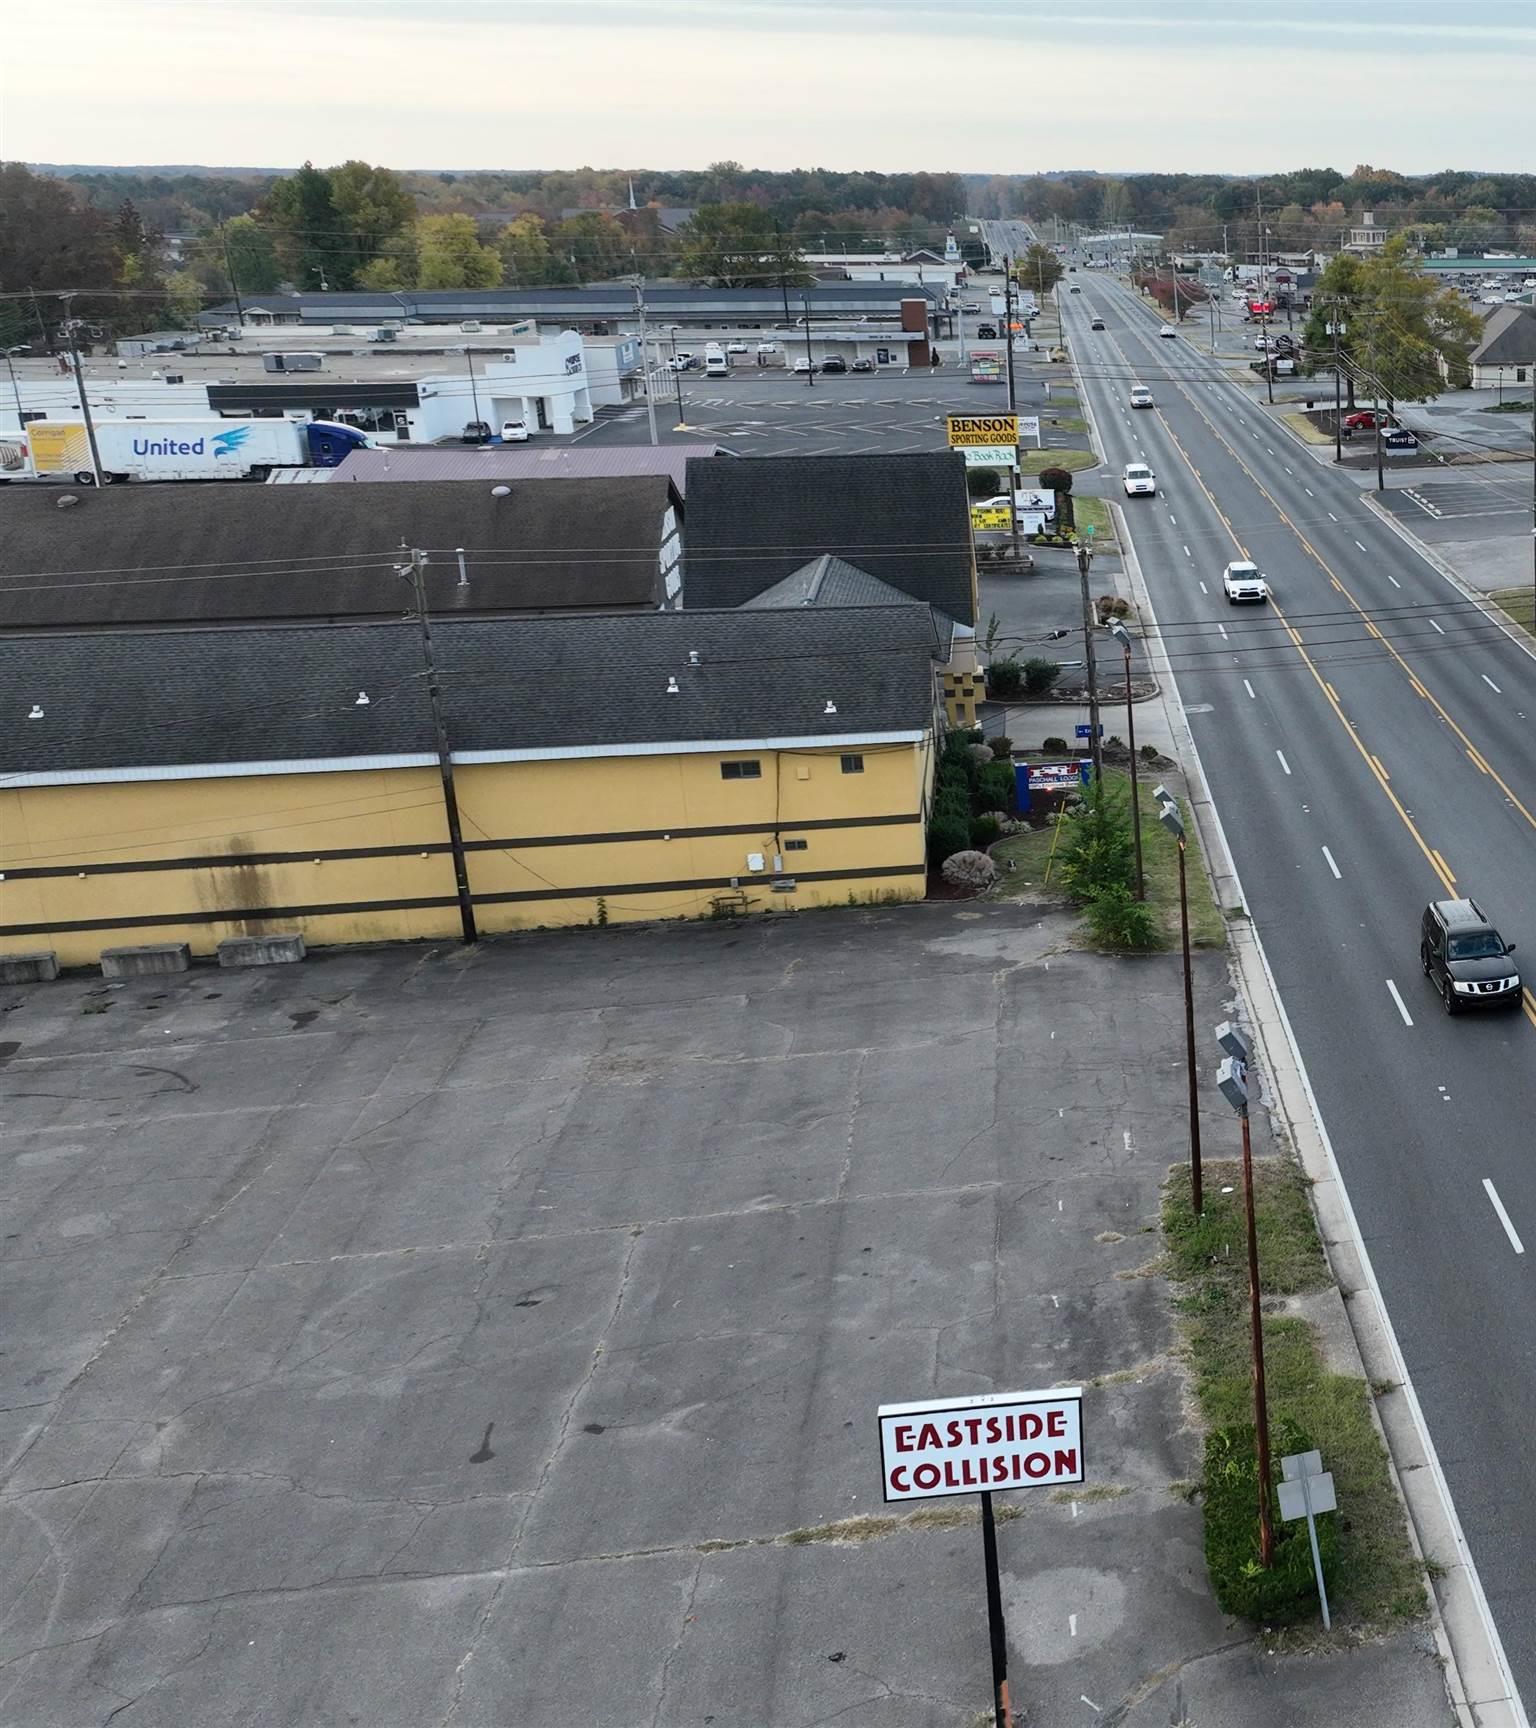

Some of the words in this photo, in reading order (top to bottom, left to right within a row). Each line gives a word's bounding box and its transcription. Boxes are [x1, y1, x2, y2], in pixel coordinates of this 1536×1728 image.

[951, 418, 1015, 432] BENSON
[133, 437, 204, 456] United
[951, 433, 989, 444] SPORTING
[990, 432, 1017, 443] GOODS
[895, 1411, 1067, 1452] EASTSIDE
[890, 1449, 1077, 1492] COLLISION
